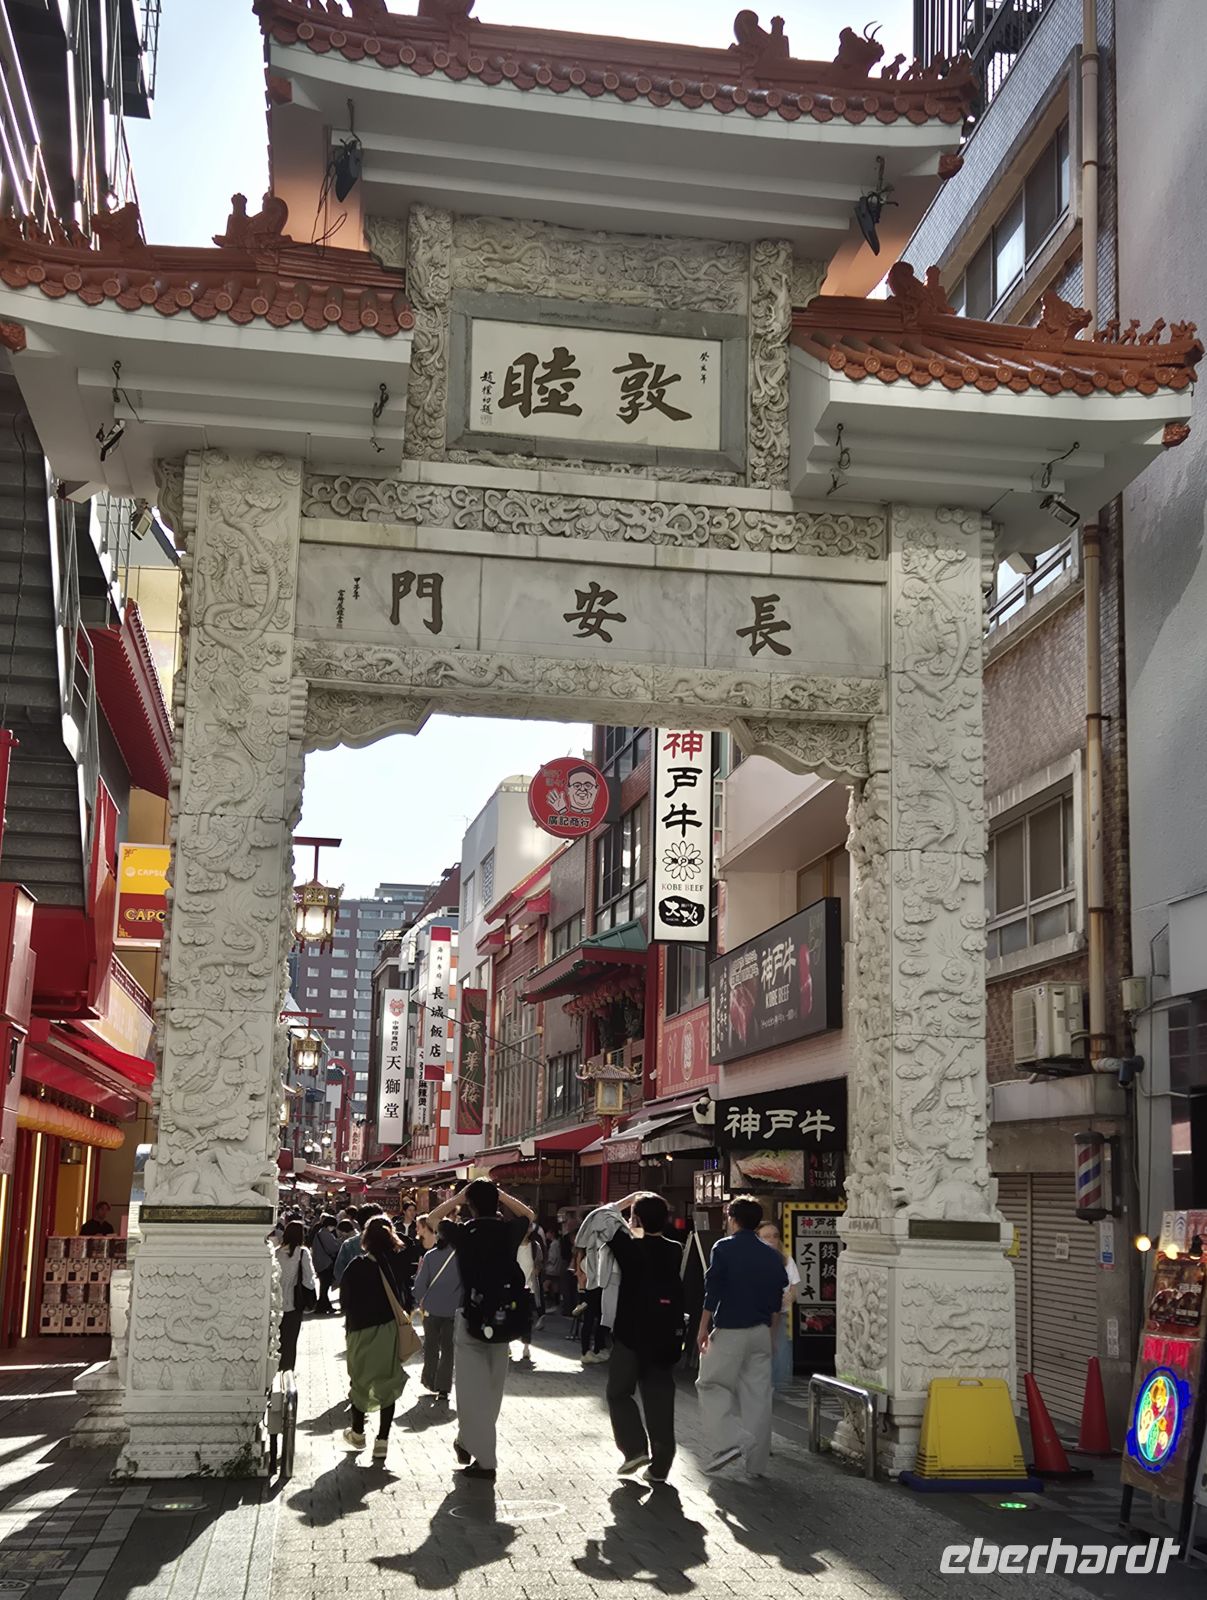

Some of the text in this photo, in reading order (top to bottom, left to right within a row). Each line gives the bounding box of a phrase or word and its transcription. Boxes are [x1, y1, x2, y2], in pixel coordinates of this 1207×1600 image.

[661, 728, 704, 838] 神戸牛
[548, 814, 591, 828] 廣記商行
[661, 883, 704, 892] KOBE BEEF
[761, 936, 796, 989] 神戸牛
[429, 988, 444, 1058] 長城飯店
[384, 1055, 401, 1119] 天獅堂
[723, 1105, 836, 1142] 神戸牛
[800, 1217, 837, 1229] 神戸牛
[800, 1242, 817, 1300] ステーキ
